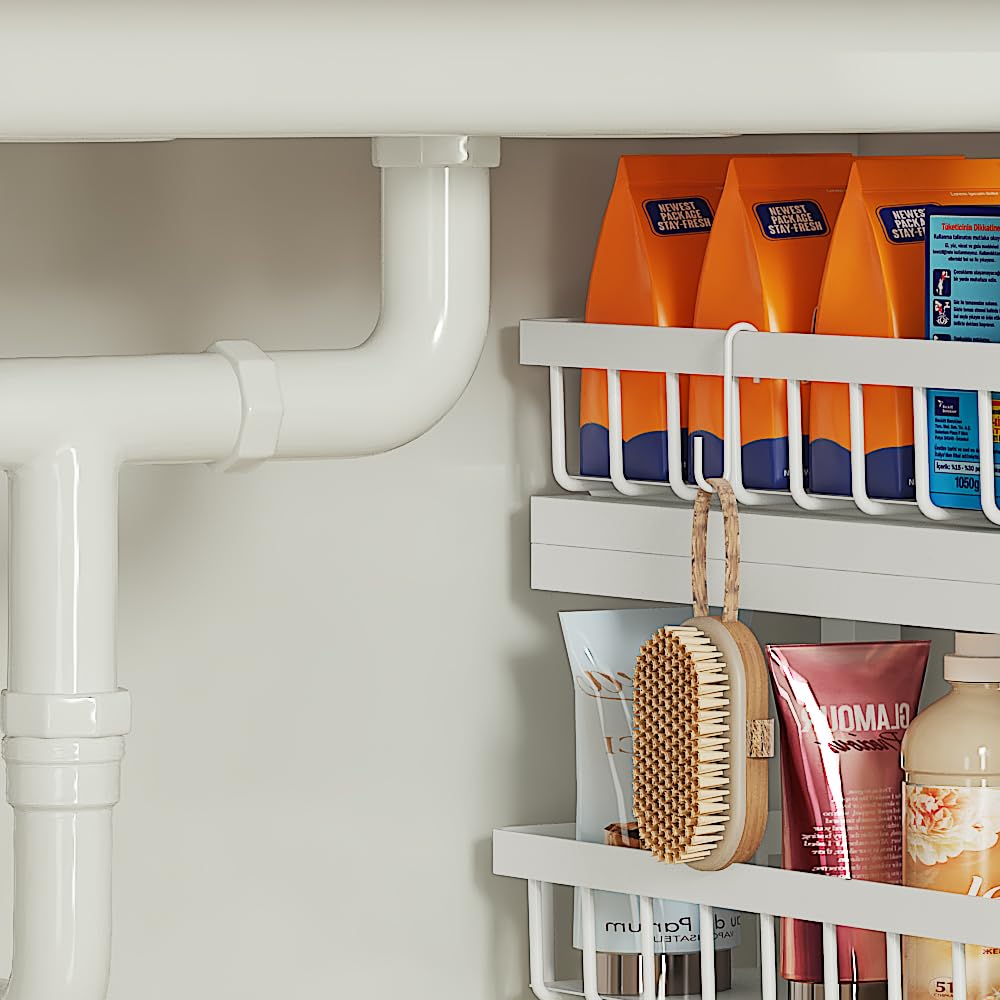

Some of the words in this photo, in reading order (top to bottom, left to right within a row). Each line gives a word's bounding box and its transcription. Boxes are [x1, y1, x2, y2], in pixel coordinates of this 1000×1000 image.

[658, 202, 696, 213] NEWEST
[768, 205, 807, 216] NEWEST
[660, 210, 703, 222] PACKAGE
[771, 213, 814, 225] PACKAGE
[892, 208, 925, 219] NEWES
[657, 218, 711, 231] STAY-FRESH
[768, 221, 823, 235] STAY-FRESH
[894, 218, 925, 228] PACKA
[892, 227, 925, 238] STAY-F
[955, 476, 980, 492] 1050g
